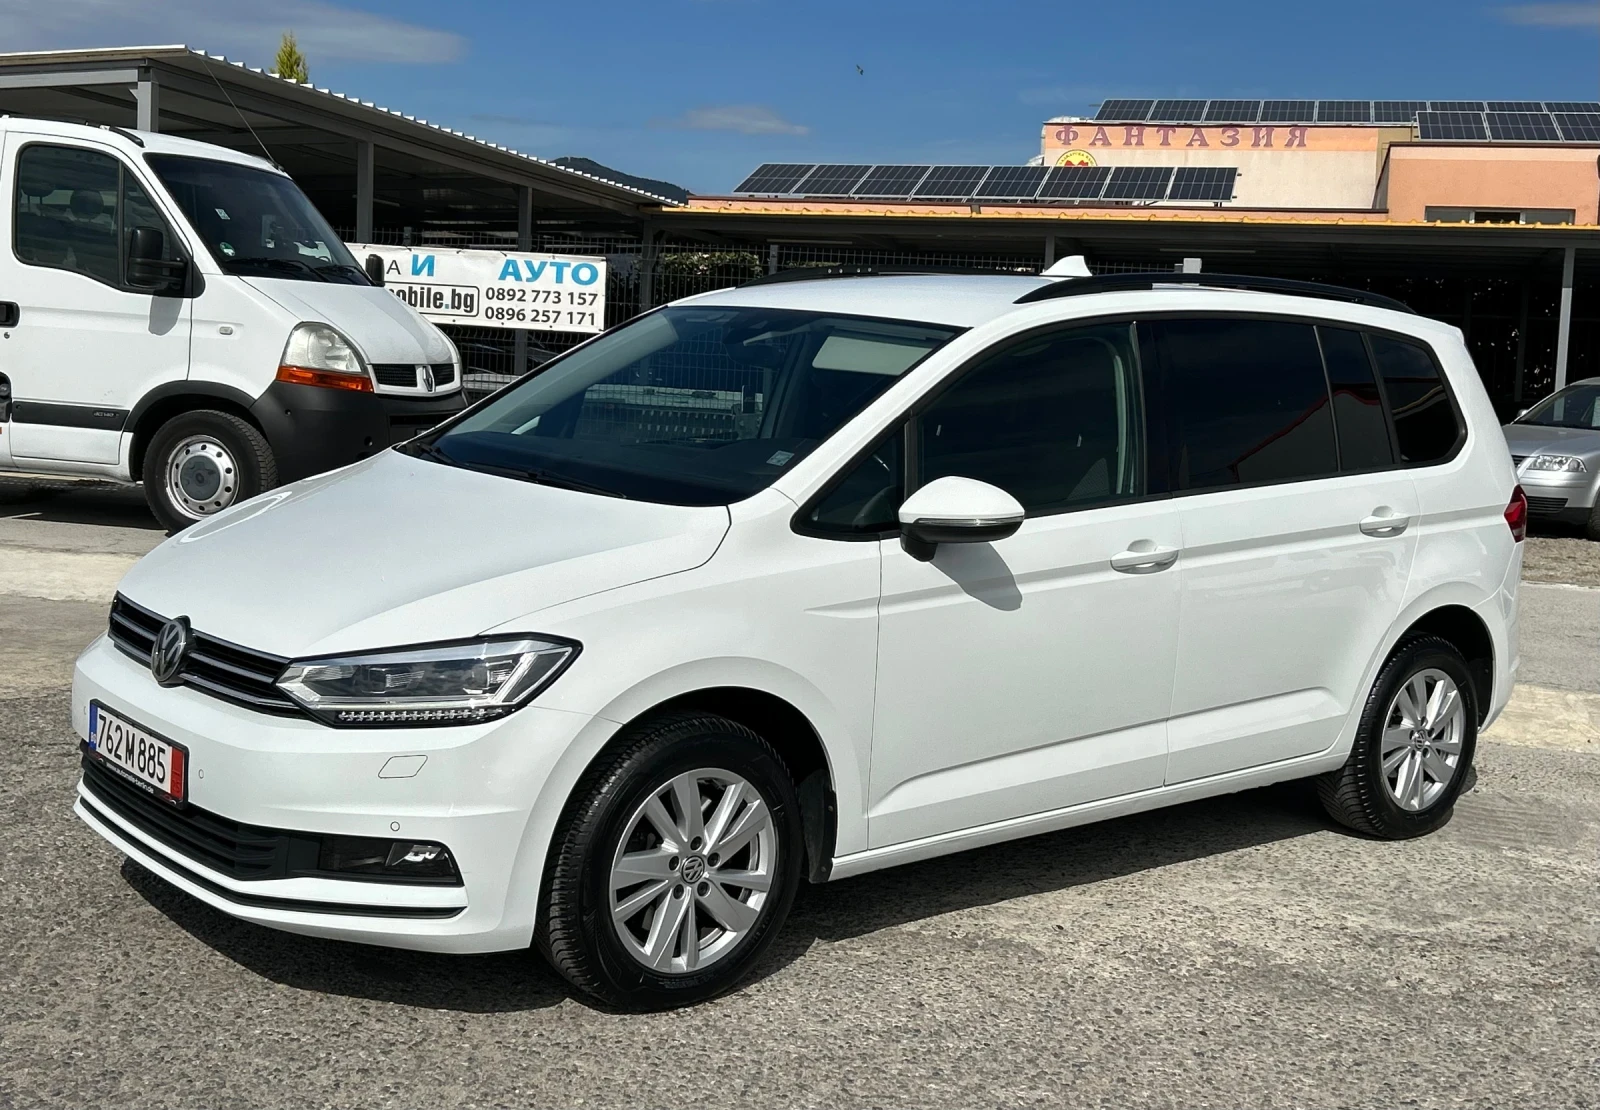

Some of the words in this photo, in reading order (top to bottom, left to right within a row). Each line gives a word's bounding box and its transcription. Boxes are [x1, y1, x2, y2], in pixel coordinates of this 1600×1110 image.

[1055, 127, 1307, 147] ФАНТАЗИЯ
[498, 258, 599, 285] АУТО
[389, 286, 475, 313] obile.bg
[485, 287, 526, 302] 0892
[531, 289, 562, 304] 773
[567, 291, 598, 306] 157
[485, 306, 526, 321] 0896
[530, 308, 561, 323] 257
[567, 311, 595, 326] 171
